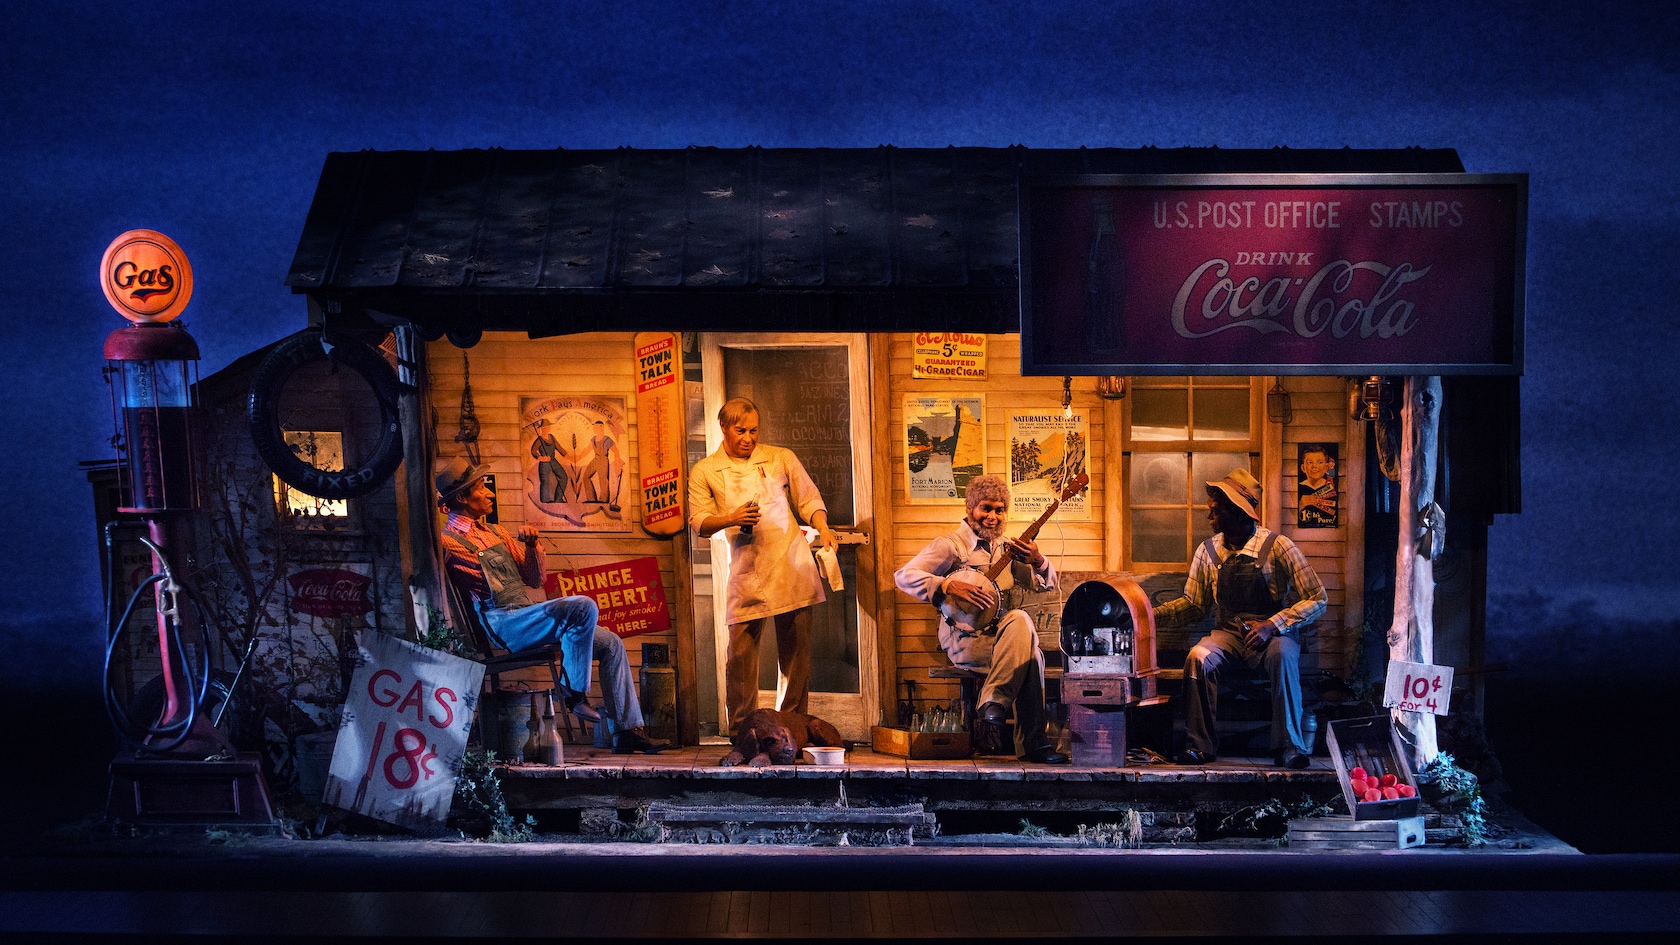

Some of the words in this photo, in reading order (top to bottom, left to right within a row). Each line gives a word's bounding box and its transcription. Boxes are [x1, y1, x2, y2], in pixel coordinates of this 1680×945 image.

[1263, 201, 1341, 228] OFFICE
[1369, 201, 1464, 228] STAMPS
[1234, 251, 1314, 266] DRINK
[113, 261, 174, 303] Gas
[1170, 257, 1434, 339] Coca-Cola
[640, 340, 669, 355] BRAUN'S
[640, 349, 672, 369] TOWN
[925, 358, 976, 366] GUARANTEED
[641, 361, 672, 381] TALK
[645, 378, 668, 390] BREAD
[302, 467, 376, 487] FIXED
[911, 476, 927, 485] FORT
[644, 480, 678, 500] TOWN
[645, 493, 678, 513] TALK
[651, 511, 673, 523] BREAD
[595, 586, 648, 610] BERT
[611, 610, 627, 622] joy
[1403, 674, 1443, 701] 10¢
[367, 668, 458, 730] GAS
[1426, 698, 1438, 713] 4
[364, 721, 439, 790] 18¢
